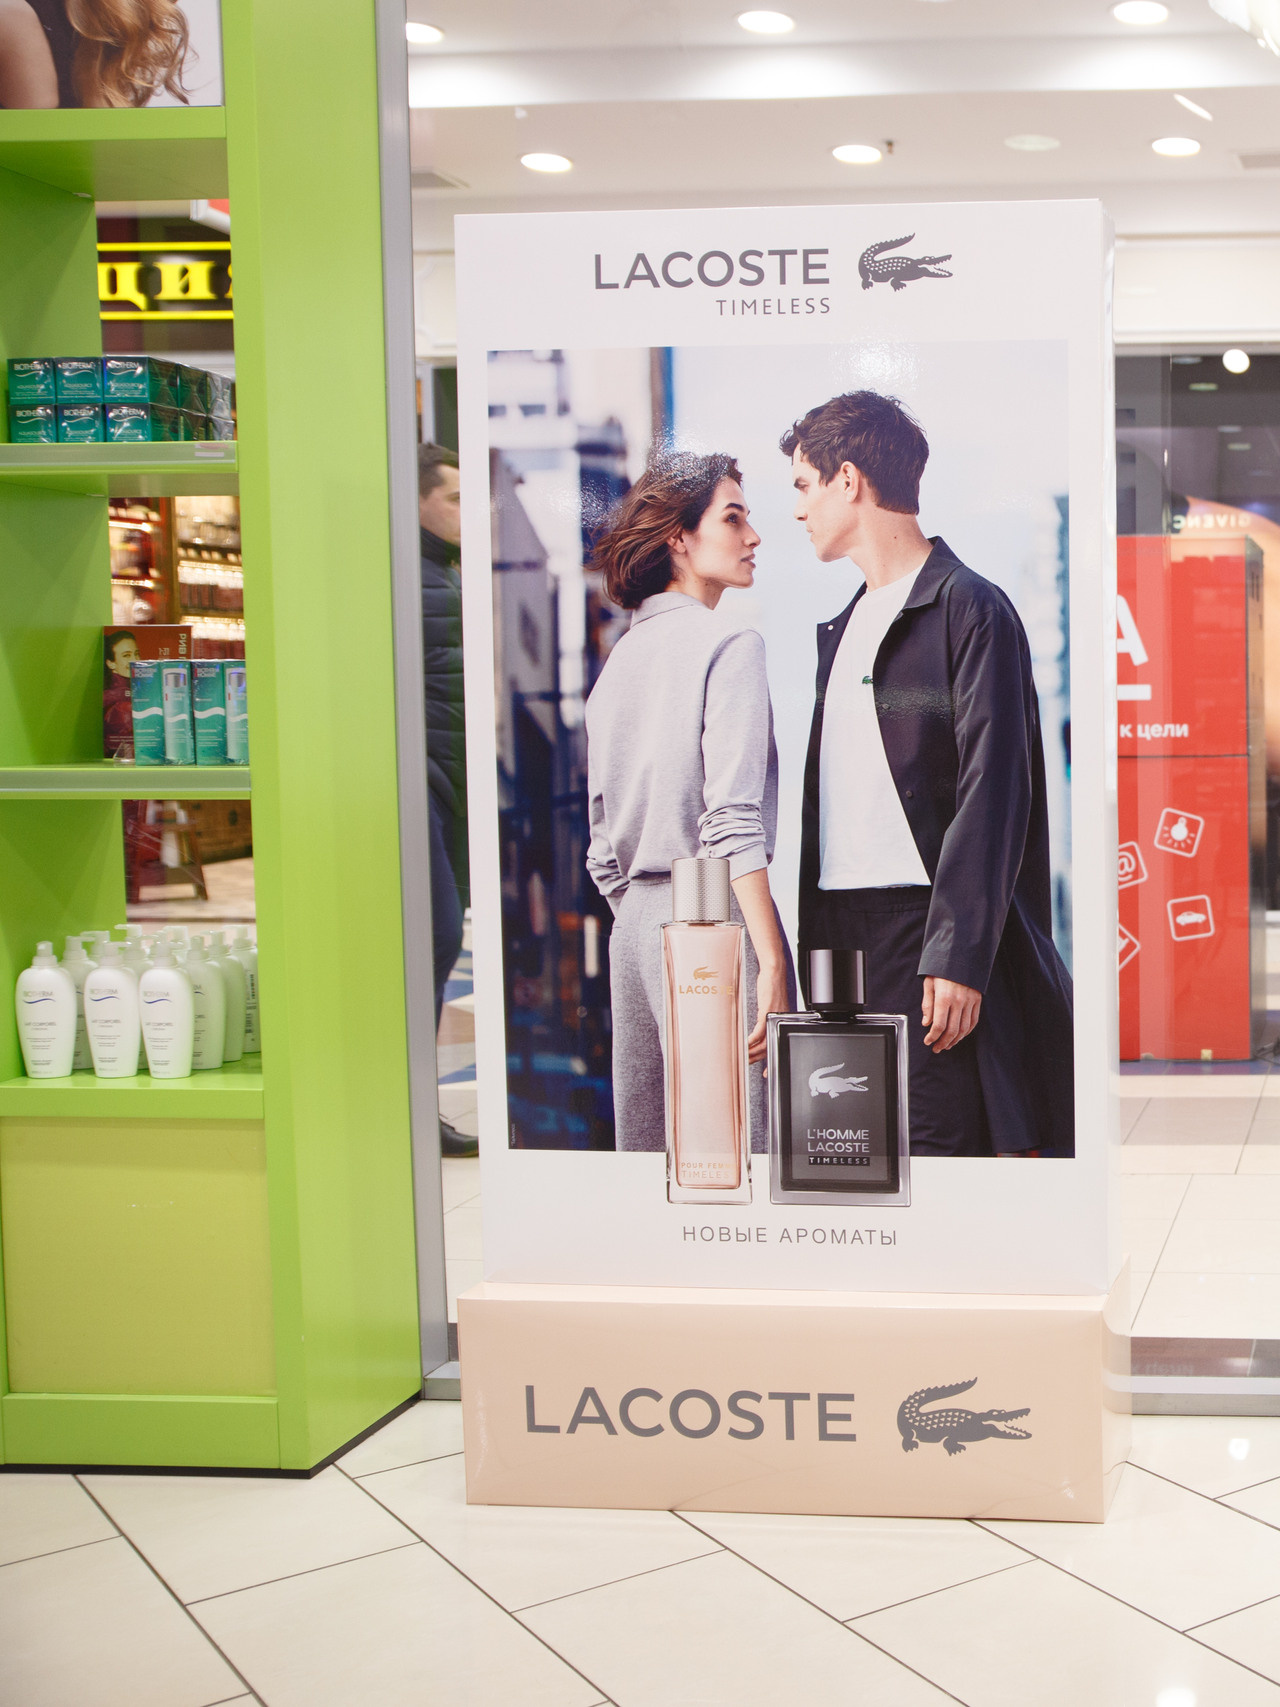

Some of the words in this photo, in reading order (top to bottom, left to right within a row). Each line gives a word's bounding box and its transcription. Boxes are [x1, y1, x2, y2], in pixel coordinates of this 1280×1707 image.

[594, 248, 830, 289] LACOSTE
[715, 297, 830, 316] TIMELESS
[1137, 724, 1189, 740] цели
[807, 1128, 870, 1141] L'HOMME
[807, 1141, 870, 1153] LACOSTE
[809, 1157, 869, 1166] TIMELESS
[682, 1226, 768, 1243] НОВЫЕ
[779, 1228, 897, 1246] АРОМАТЫ
[525, 1385, 857, 1442] LACOSTE
